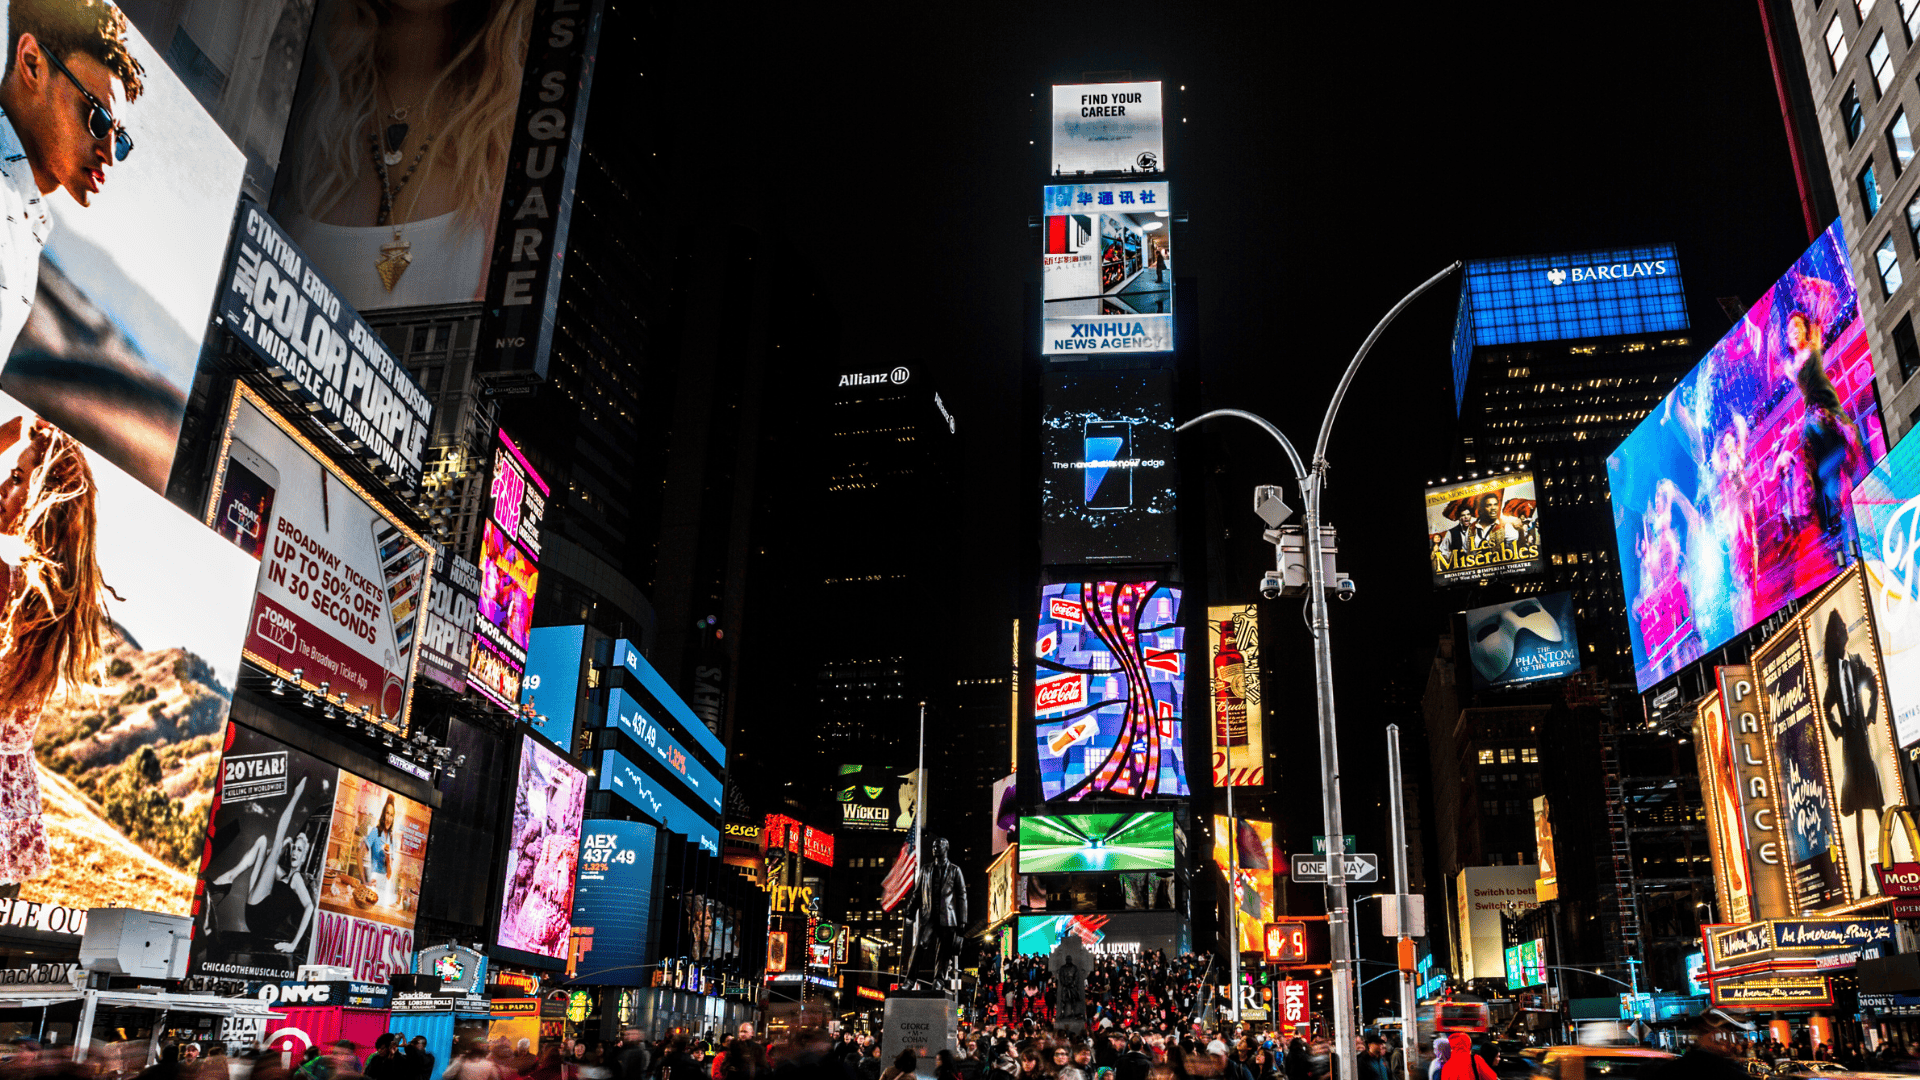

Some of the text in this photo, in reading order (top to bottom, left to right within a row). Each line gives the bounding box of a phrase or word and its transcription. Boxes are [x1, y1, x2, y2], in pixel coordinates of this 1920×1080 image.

[1081, 93, 1141, 105] FIND YOUR
[1081, 106, 1126, 118] CAREER
[503, 70, 568, 307] SQUARE
[231, 242, 262, 306] THE
[1571, 260, 1666, 282] BARCLAYS
[246, 208, 433, 426] CYNTHIA ERIVO JENNIFER HUDSON
[1071, 322, 1146, 338] XINHUA
[495, 337, 526, 349] NYC
[1054, 336, 1163, 350] NEWS AGENCY
[253, 260, 428, 472] COLOR PURPLE
[256, 322, 323, 400] MIRACLE
[323, 385, 344, 419] ON
[838, 373, 888, 387] Allianz
[1052, 461, 1069, 469] The
[1141, 459, 1165, 469] edge
[234, 499, 259, 521] TODAY
[1470, 535, 1497, 552] Les
[277, 516, 383, 603] BROADWAY TICKETS
[452, 553, 478, 578] JENNIFER
[1435, 539, 1540, 572] Misérables
[273, 536, 381, 622] UP TO 50% OFF
[450, 564, 481, 596] HUDSON
[268, 559, 378, 645] IN 30 SECONDS
[1052, 603, 1081, 620] Coca-Cola
[264, 606, 297, 635] TODAY
[270, 623, 287, 646] TIX
[421, 611, 474, 667] URPLE
[626, 650, 637, 670] AEX
[1515, 649, 1575, 668] PHANTOM
[1537, 646, 1551, 654] THE
[299, 638, 368, 691] The Broadway Ticket App
[1520, 659, 1572, 674] OF THE OPERA
[1037, 681, 1080, 707] Coca-Cola
[631, 710, 657, 749] 437.49
[1735, 680, 1779, 865] PALACE
[584, 834, 618, 850] AEX
[582, 848, 636, 864] 437.49
[582, 863, 609, 872] -1.32%
[1300, 863, 1325, 873] ONE
[1474, 888, 1505, 897] Switch
[1506, 887, 1516, 895] to
[1475, 901, 1540, 911] Switch Fios.
[1797, 925, 1846, 945] American
[314, 911, 412, 985] WAITRESS
[1107, 942, 1140, 954] LUXURY
[1816, 948, 1880, 968] CHANGE MONEY ATM
[201, 961, 296, 979] CHICAGOTHEMUSICAL.COM
[281, 985, 330, 1003] NYC
[350, 984, 388, 995] The Official Guide
[399, 991, 432, 999] SnackBox
[1239, 985, 1264, 1010] R
[1285, 983, 1305, 1022] tkts
[1860, 998, 1895, 1006] MONEY
[900, 1022, 930, 1030] GEORGE
